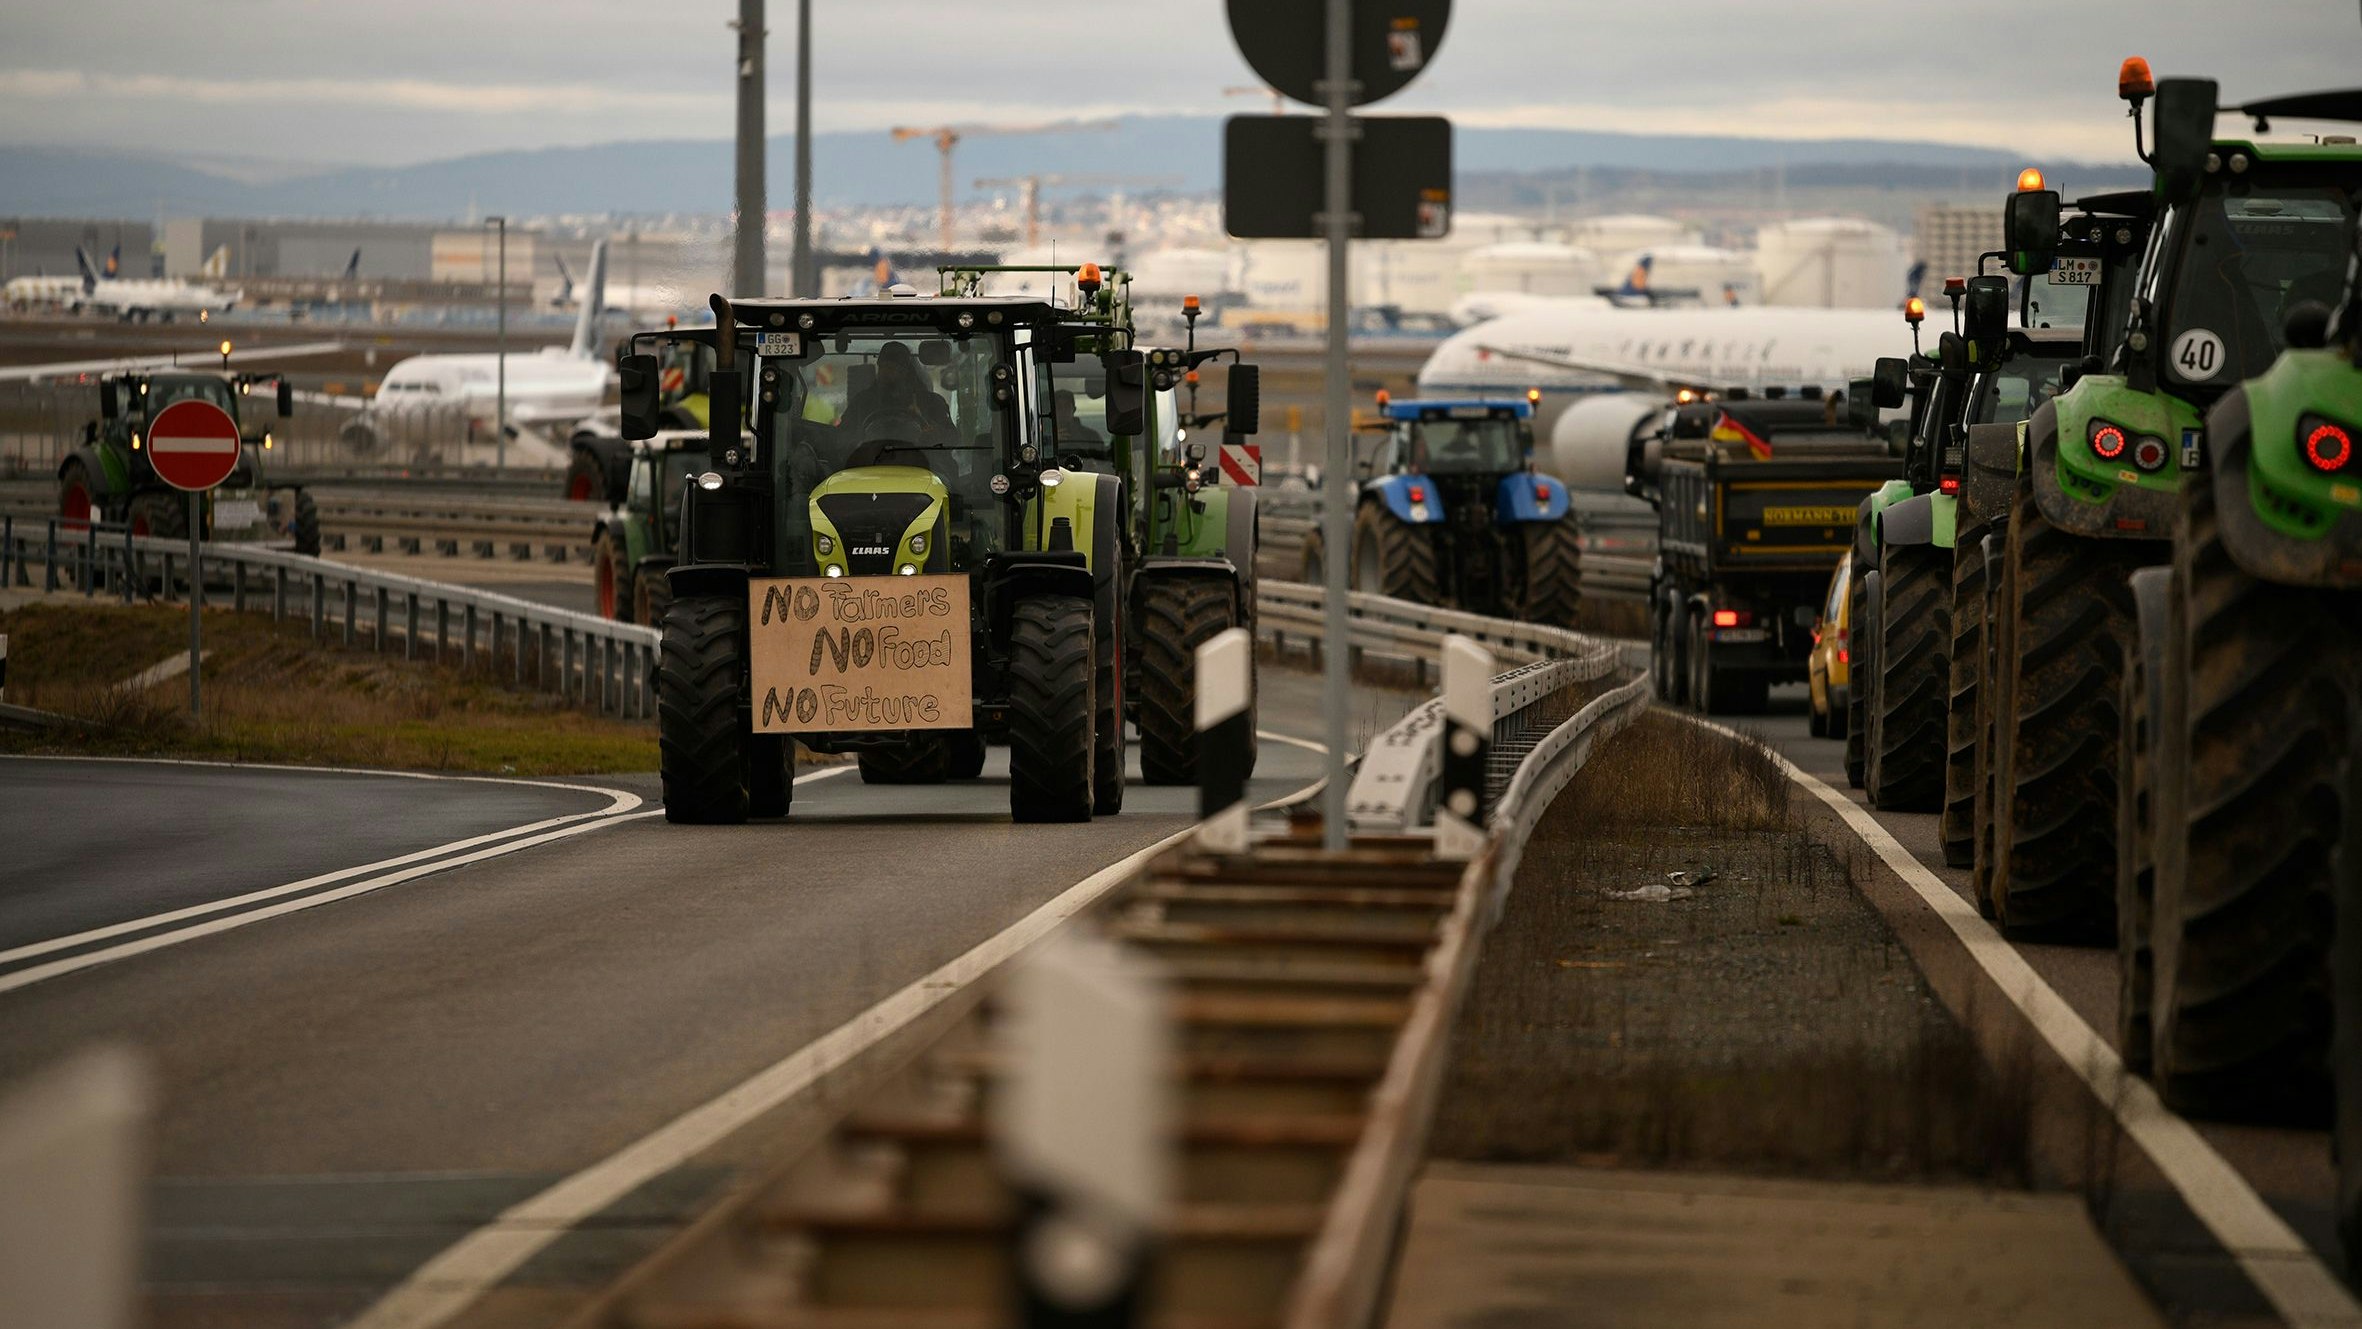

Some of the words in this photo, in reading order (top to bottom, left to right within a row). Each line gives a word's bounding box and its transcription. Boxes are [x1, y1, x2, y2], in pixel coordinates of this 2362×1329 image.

[2058, 259, 2075, 271] LM
[2058, 271, 2066, 283] S
[2068, 271, 2092, 283] 817
[841, 312, 930, 323] ARION
[767, 334, 782, 344] GG
[765, 344, 772, 355] R
[774, 344, 794, 354] 323
[2180, 338, 2215, 371] 40
[852, 546, 890, 555] CLAAS
[761, 584, 820, 626] NO
[821, 582, 951, 623] Farmers
[809, 625, 875, 676] NO
[877, 625, 951, 670] Food
[762, 686, 818, 728] NO
[820, 684, 941, 725] Future
